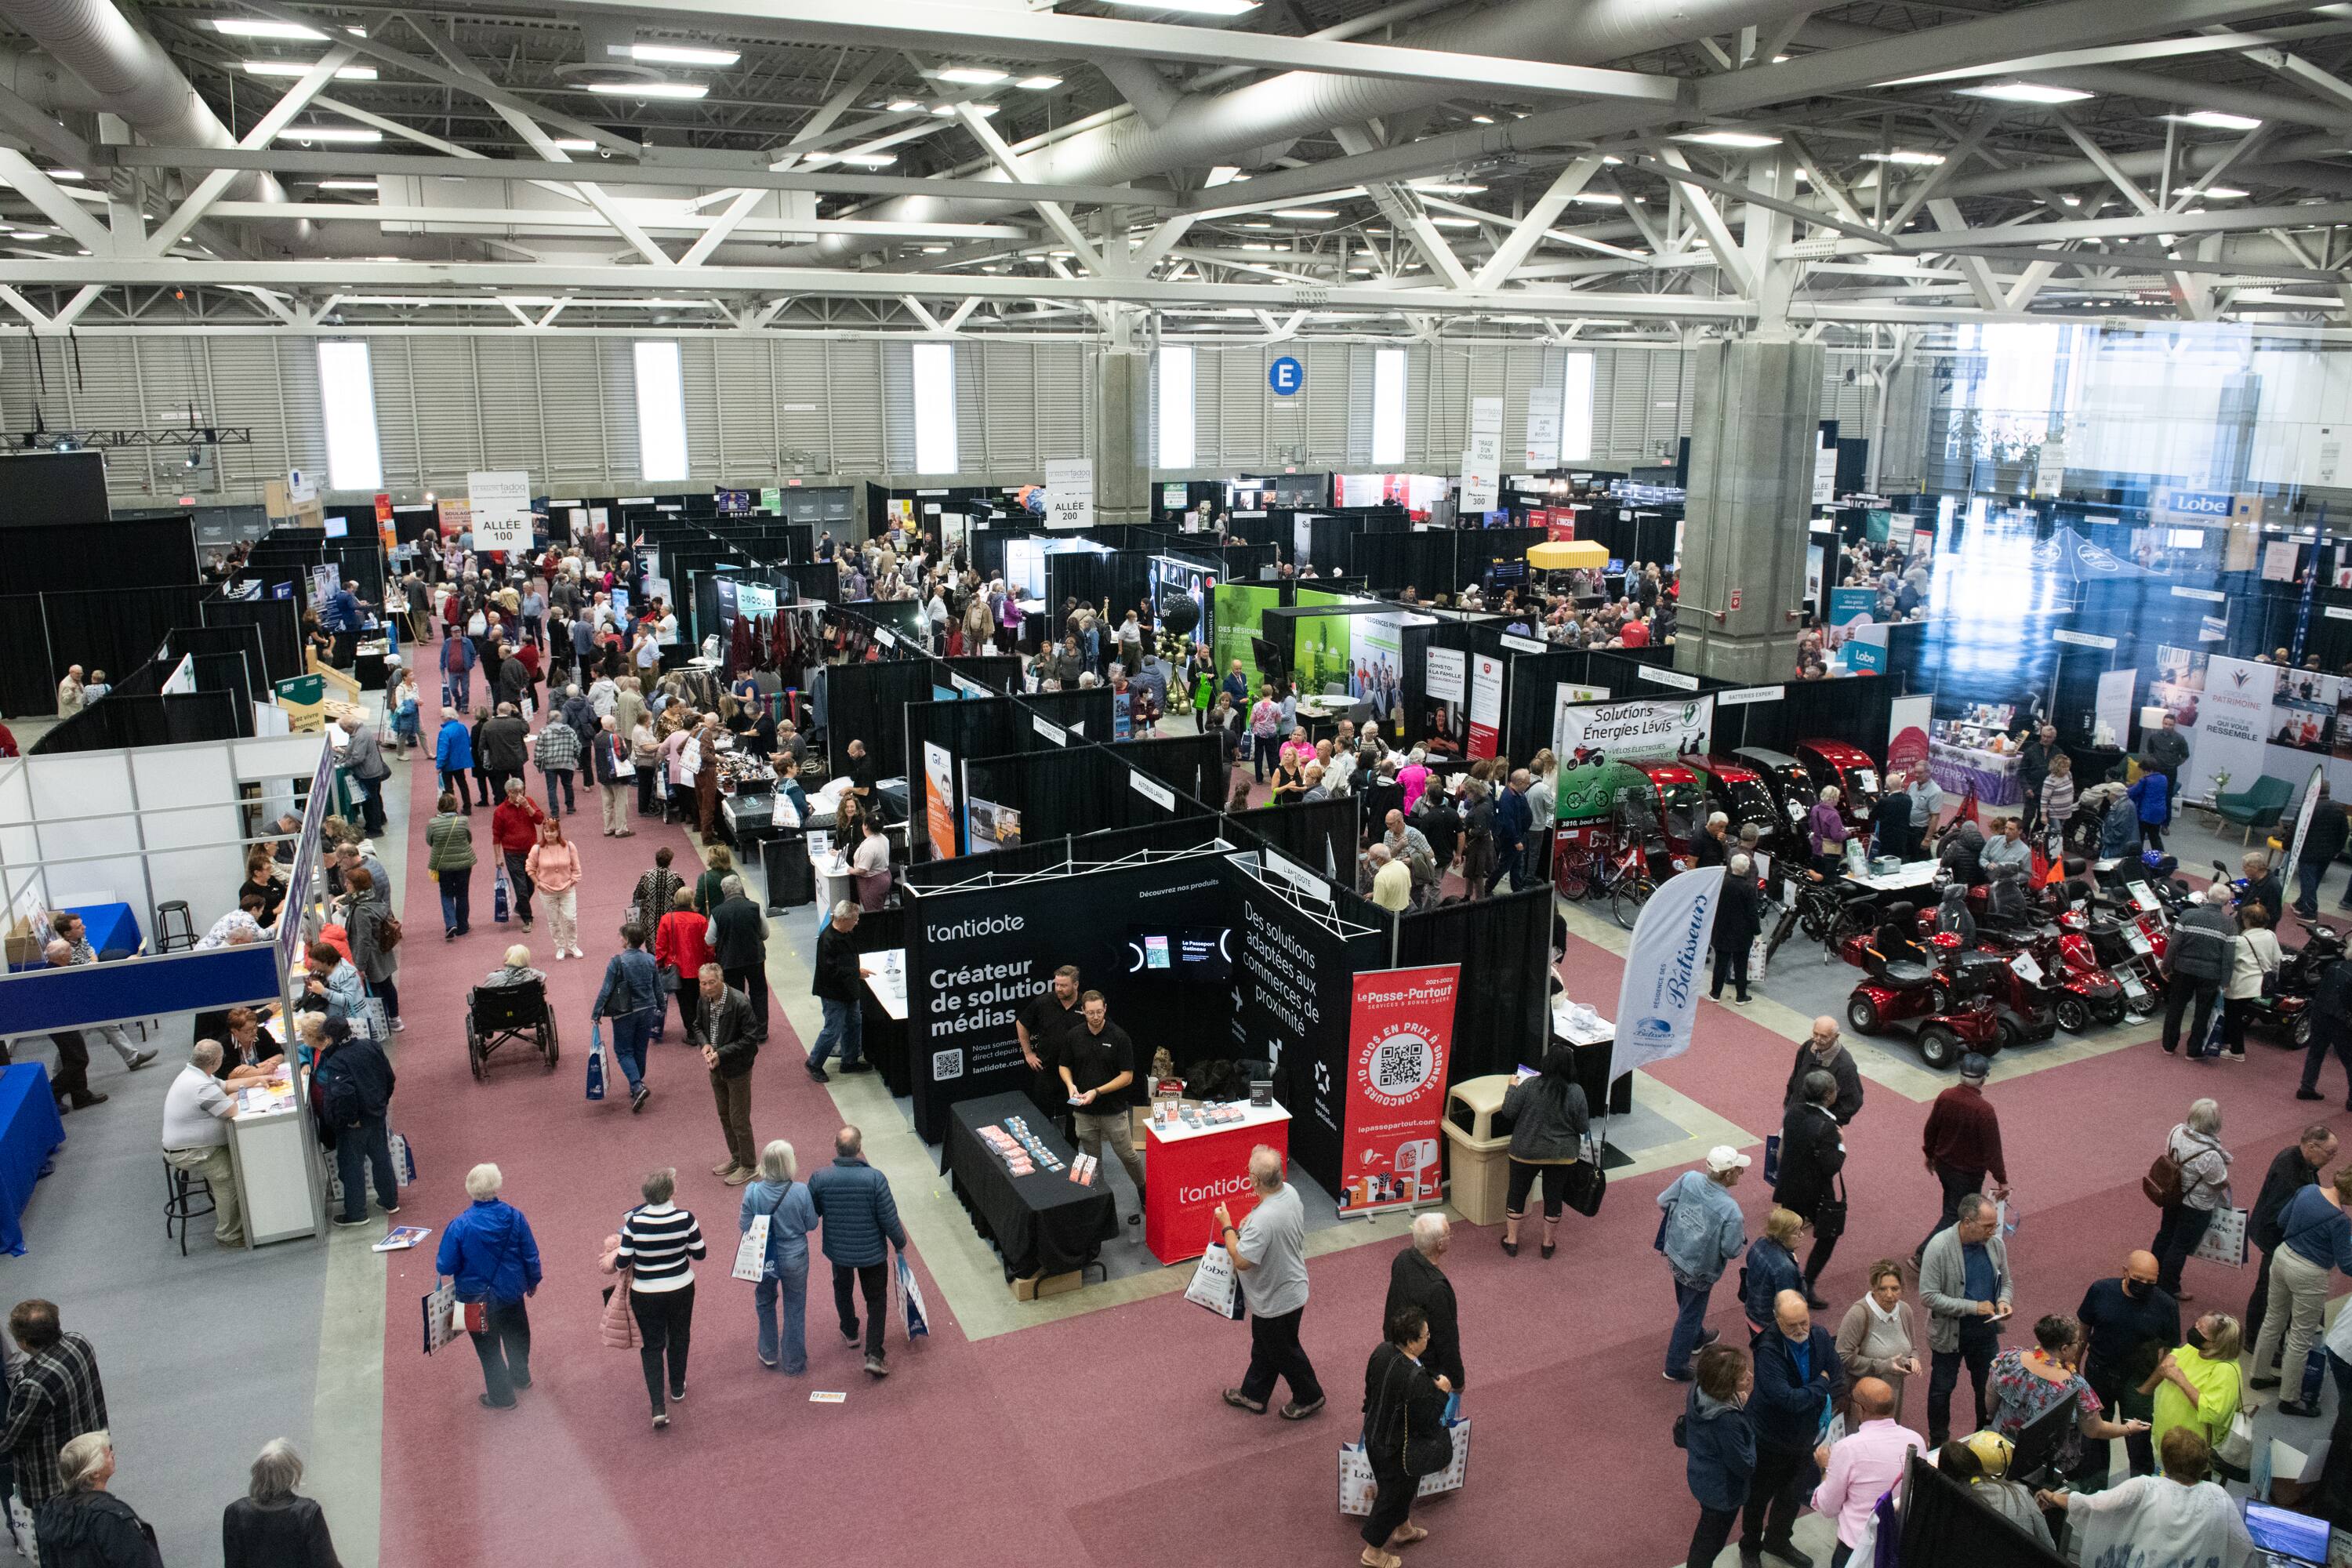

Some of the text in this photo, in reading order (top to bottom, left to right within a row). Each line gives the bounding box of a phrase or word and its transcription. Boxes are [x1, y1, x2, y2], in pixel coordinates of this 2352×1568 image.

[1279, 364, 1294, 387] E
[1813, 481, 1829, 490] LLÉE
[1055, 500, 1084, 511] ALLÉE
[2177, 495, 2227, 513] Lobe
[484, 518, 521, 530] ALLÉE
[1062, 512, 1078, 521] 200
[494, 532, 513, 541] 100
[1856, 649, 1875, 663] Lobe
[2212, 695, 2262, 710] PATRIMOINE
[1595, 706, 1654, 722] Solutions
[1583, 720, 1672, 741] Énergies Lévis
[2206, 724, 2259, 742] RESSEMBLE
[2230, 722, 2249, 731] VOUS
[1561, 819, 1578, 828] 3810,
[1139, 878, 1219, 898] Découvrez nos produits
[927, 914, 1025, 943] l'antidote
[1245, 900, 1316, 969] Des solutions
[1666, 895, 1708, 1009] Bâtisseurs
[1247, 930, 1317, 996] adaptées aux
[930, 960, 1033, 989] Créateur
[1425, 977, 1454, 985] 2021-2022
[931, 978, 1056, 1013] de solution
[1243, 951, 1319, 1024] commerces de
[1357, 985, 1452, 1004] Le Passe-Partout
[1653, 977, 1664, 1009] RÉSIDENCE
[1255, 984, 1305, 1037] proximité
[931, 1007, 1016, 1037] médias
[972, 1047, 1018, 1062] direct depuis
[972, 1059, 1025, 1074] lantidote.com
[1358, 1022, 1443, 1106] CONCOURS 10 000$ EN PRIX À GAGNER
[1358, 1119, 1436, 1134] lepassepartout.com
[1179, 1175, 1254, 1204] l'antido
[2209, 1222, 2232, 1233] obe
[1201, 1260, 1229, 1276] Lobe
[1354, 1469, 1375, 1480] Lob
